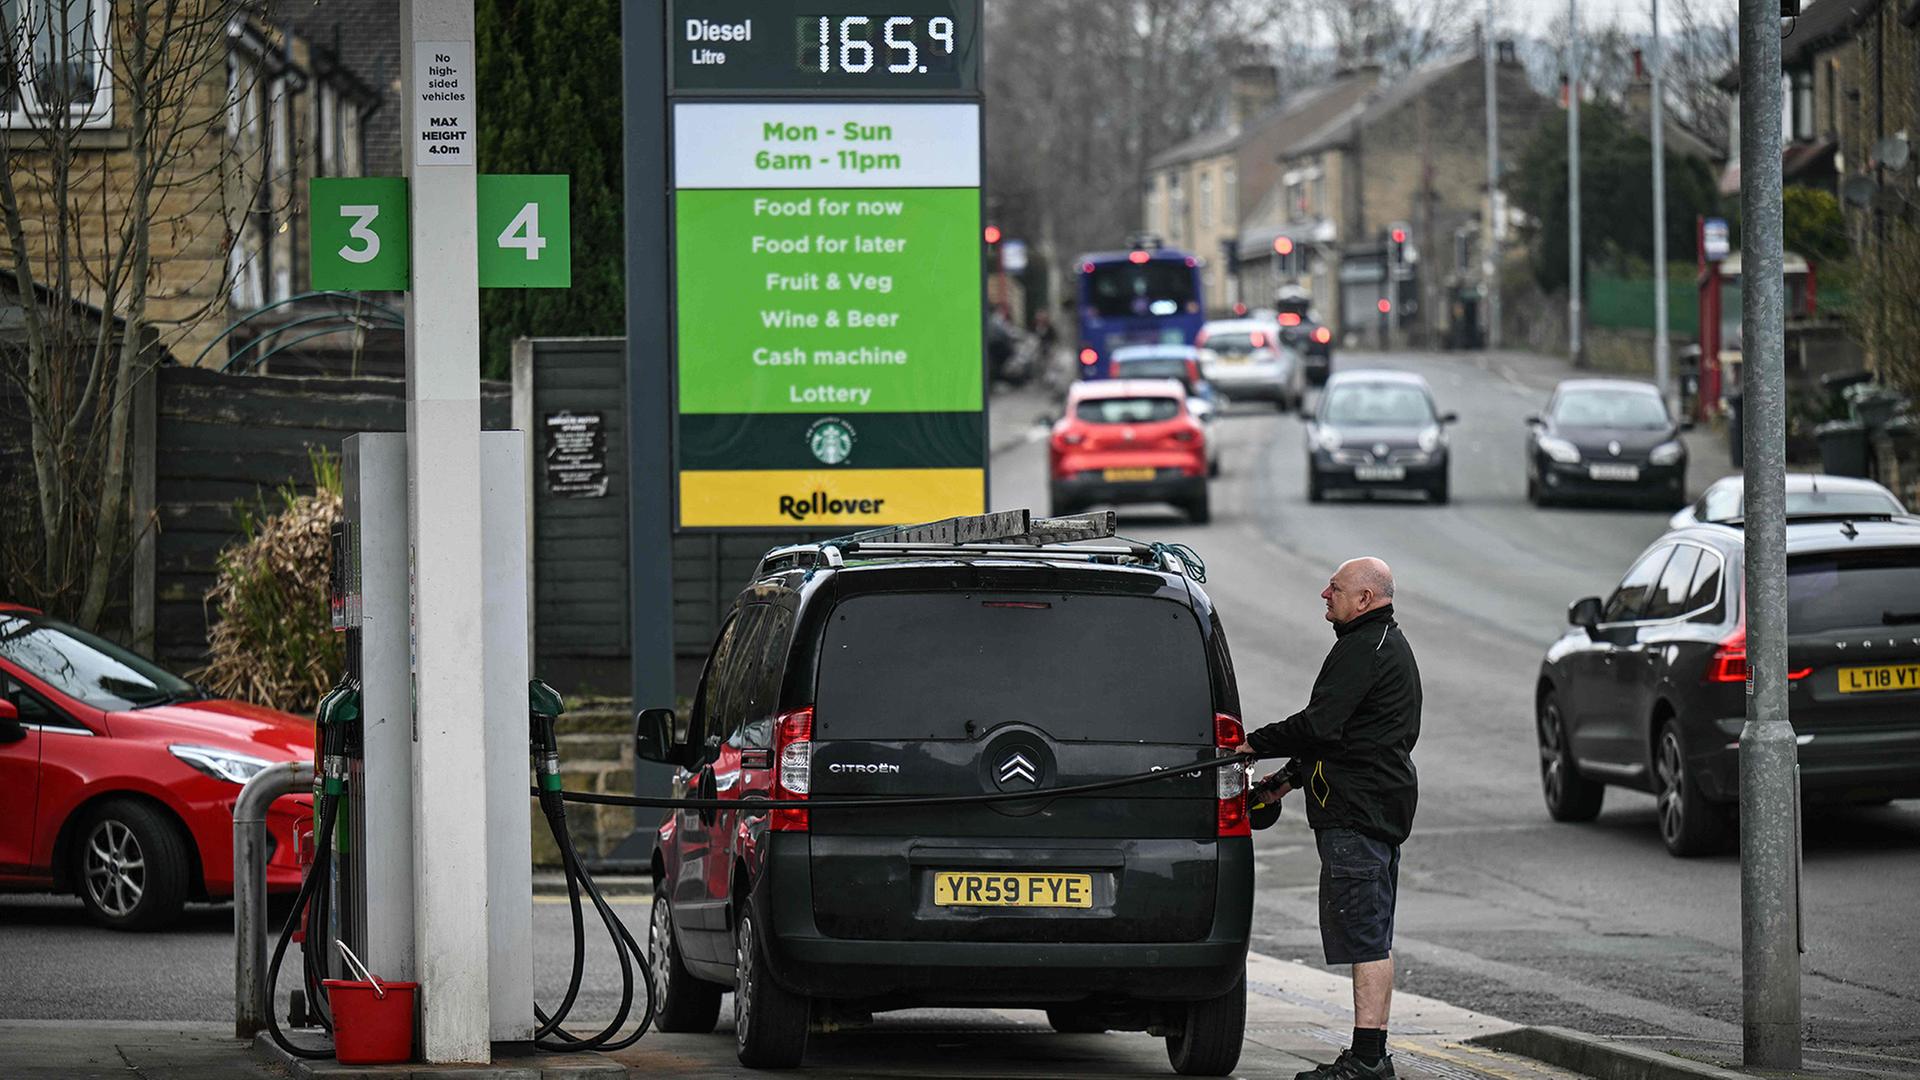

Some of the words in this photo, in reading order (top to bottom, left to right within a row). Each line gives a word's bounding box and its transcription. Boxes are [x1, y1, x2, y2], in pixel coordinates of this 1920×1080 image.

[686, 20, 751, 41] Diesel
[435, 54, 450, 62] No
[692, 49, 725, 64] Litre
[429, 66, 456, 76] high-
[429, 79, 458, 88] sided
[422, 92, 465, 101] vehicles
[430, 117, 458, 127] MAX
[422, 131, 467, 141] HEIGHT
[763, 122, 817, 141] Mon
[844, 122, 892, 141] Sun
[429, 145, 460, 154] 4.0m
[755, 151, 811, 170] 6am
[837, 150, 901, 173] 11pm
[754, 198, 811, 216] Food
[818, 198, 850, 216] for
[857, 202, 904, 216] now
[338, 205, 380, 263] 3
[497, 203, 546, 260] 4
[752, 236, 809, 253] Food
[816, 235, 848, 253] for
[855, 235, 906, 253] later
[766, 273, 819, 290] Fruit
[826, 273, 840, 290] &
[848, 273, 893, 293] Veg
[761, 310, 818, 328] Wine
[825, 310, 840, 327] &
[847, 310, 899, 327] Beer
[753, 348, 806, 365] Cash
[814, 347, 907, 365] machine
[790, 386, 871, 405] Lottery
[779, 492, 884, 519] Rollover
[1850, 669, 1891, 688] LT18
[829, 762, 899, 774] CITROËN
[948, 876, 1019, 902] YR59
[1029, 876, 1081, 903] FYE
